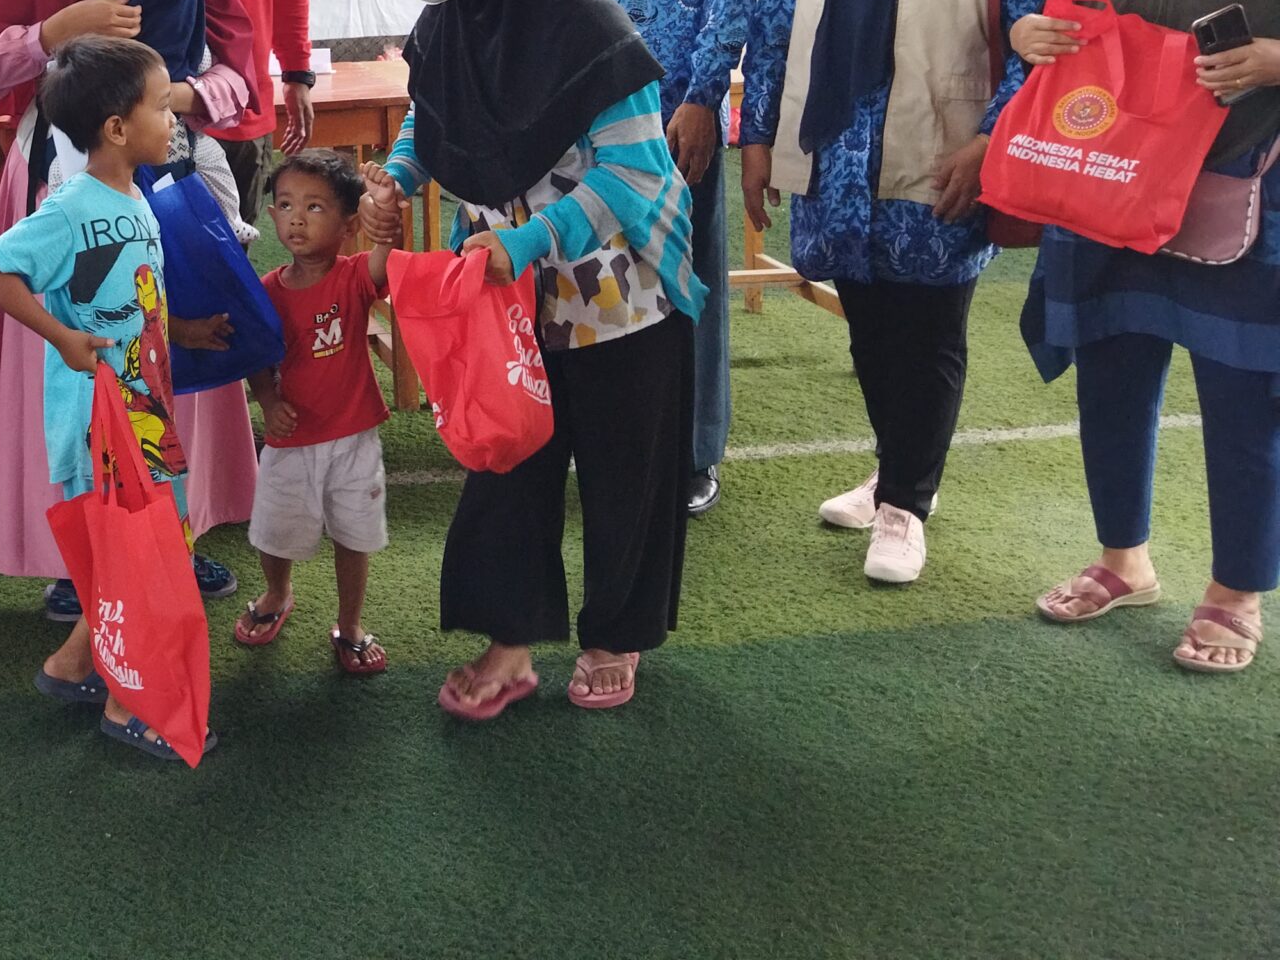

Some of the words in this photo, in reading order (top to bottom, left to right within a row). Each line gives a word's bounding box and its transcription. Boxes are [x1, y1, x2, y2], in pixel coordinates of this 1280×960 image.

[1086, 151, 1140, 171] SEHAT
[1083, 163, 1137, 183] HEBAT
[81, 214, 151, 250] IRON
